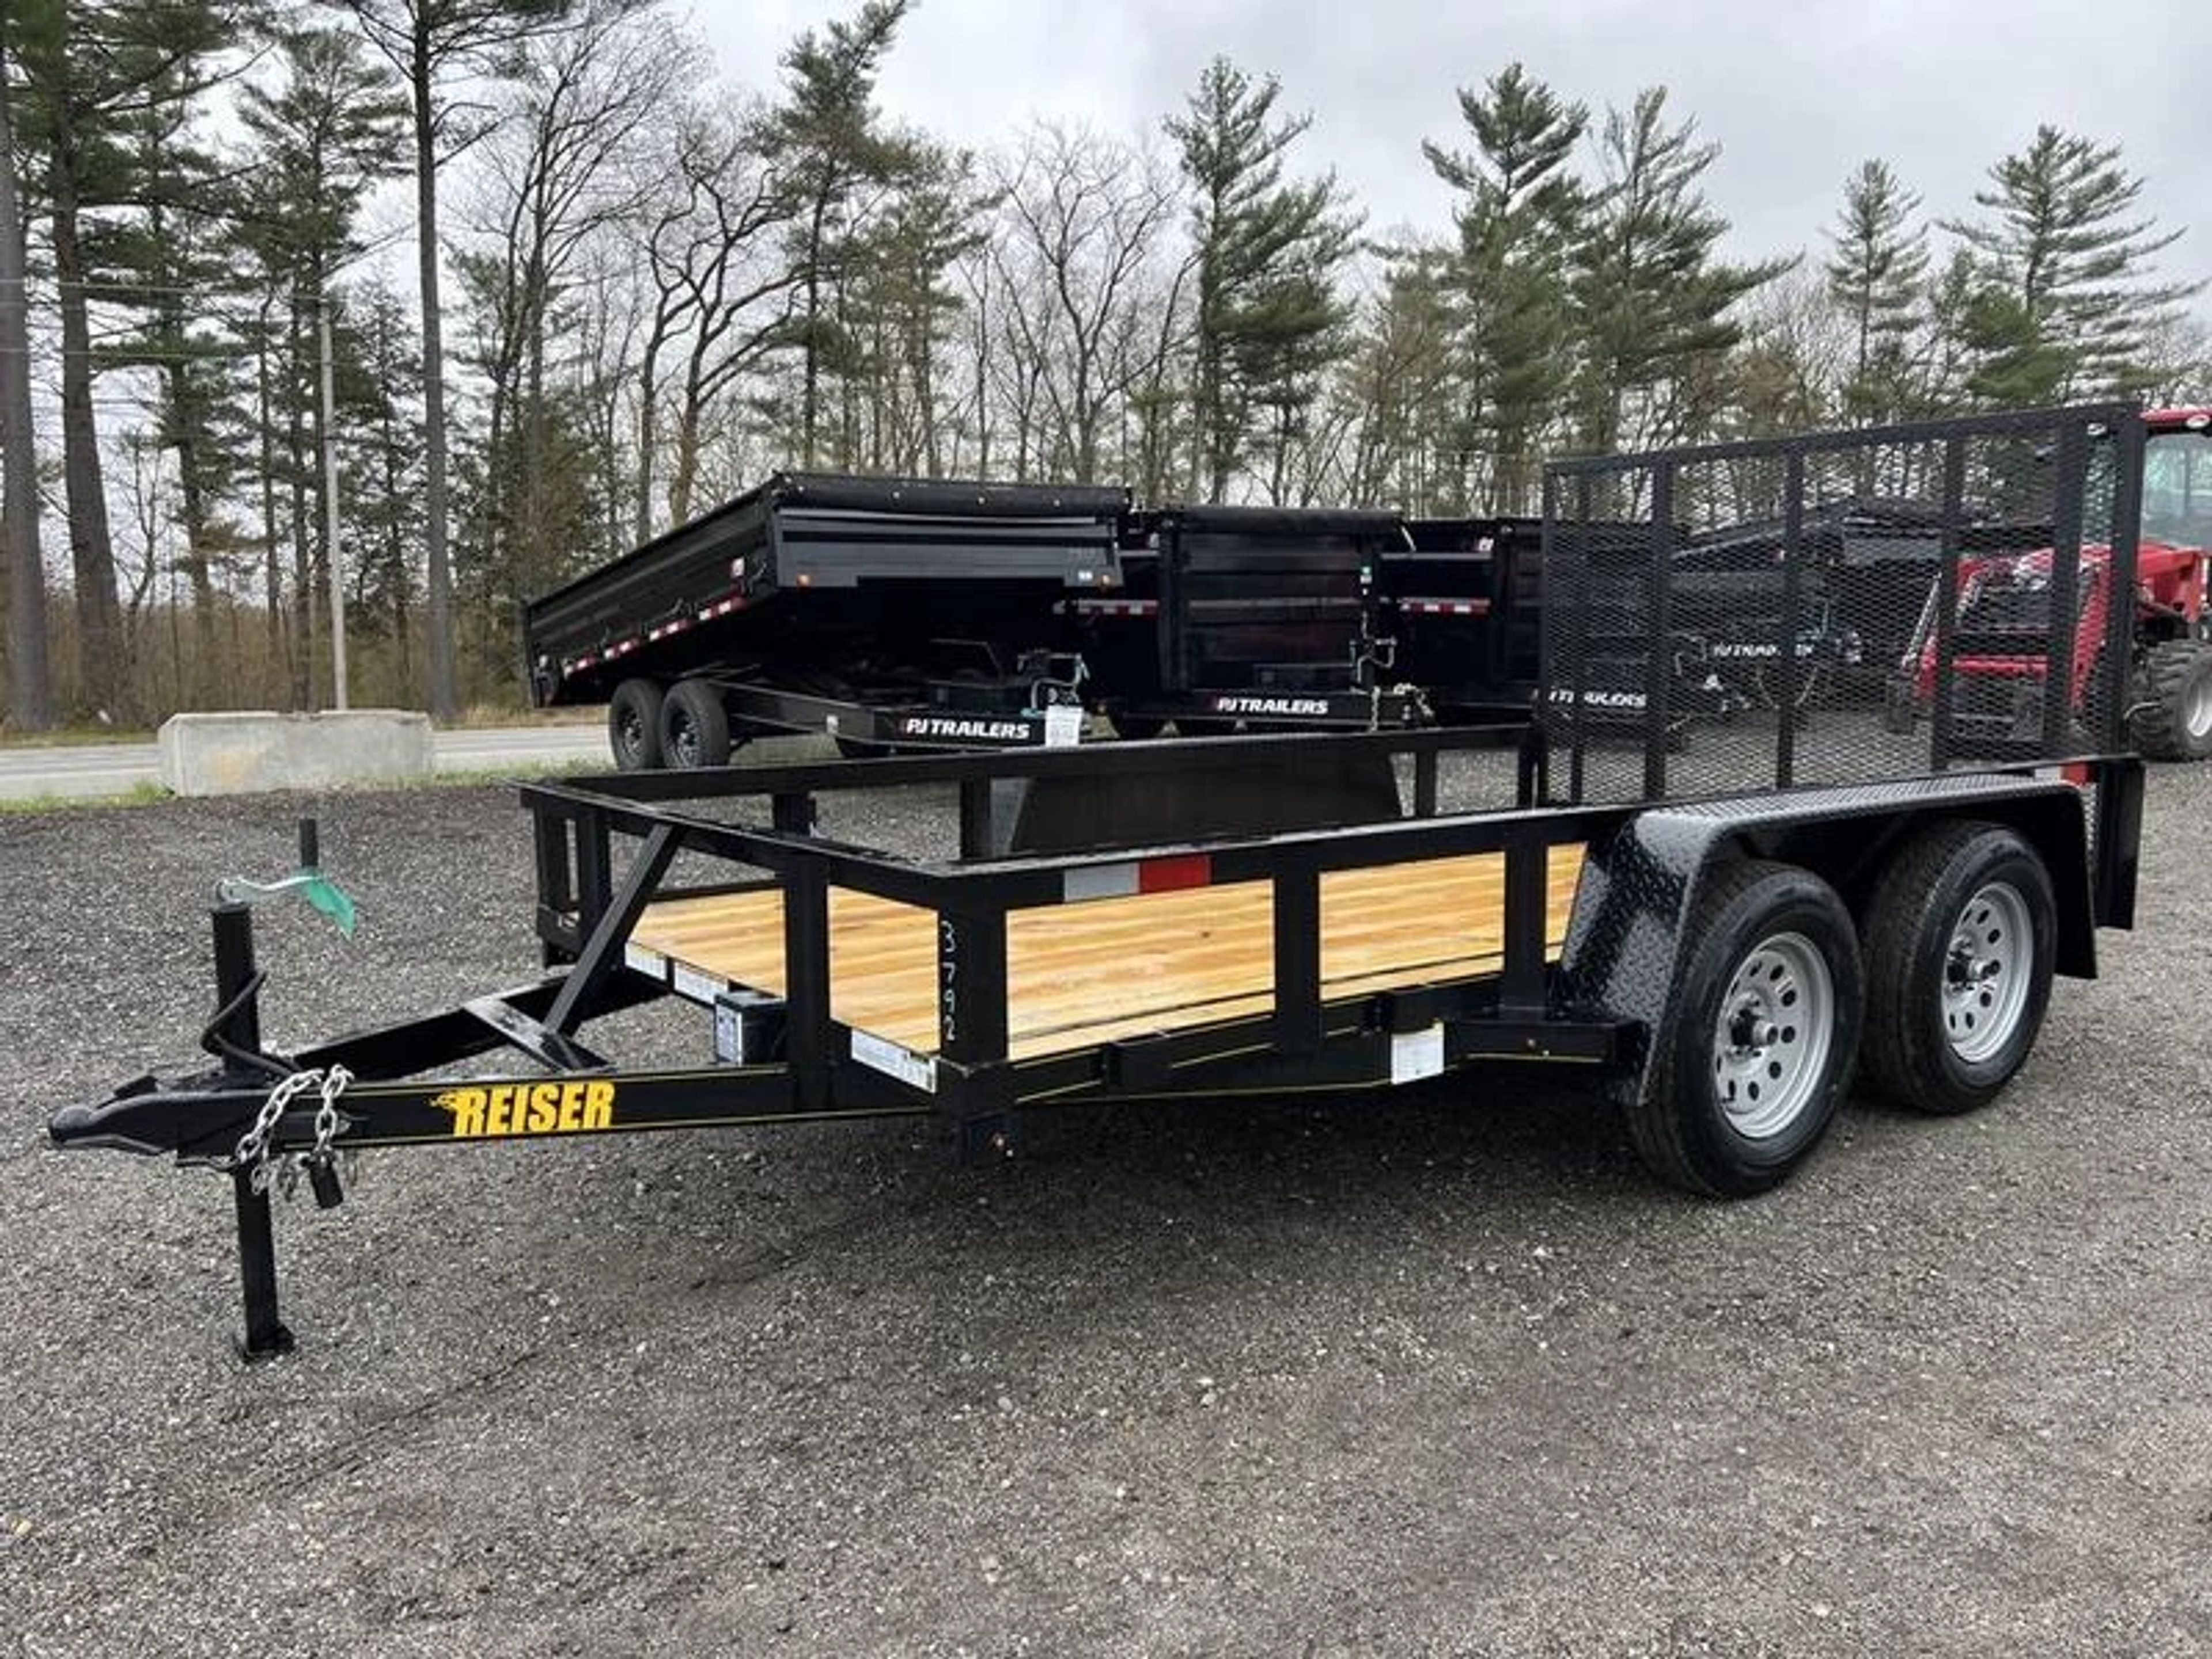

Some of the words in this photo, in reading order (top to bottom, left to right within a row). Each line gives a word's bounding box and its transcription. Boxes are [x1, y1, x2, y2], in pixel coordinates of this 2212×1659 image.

[1240, 698, 1328, 714] TRAILERS
[931, 719, 1030, 739] TRAILERS
[453, 1081, 615, 1138] REISER
